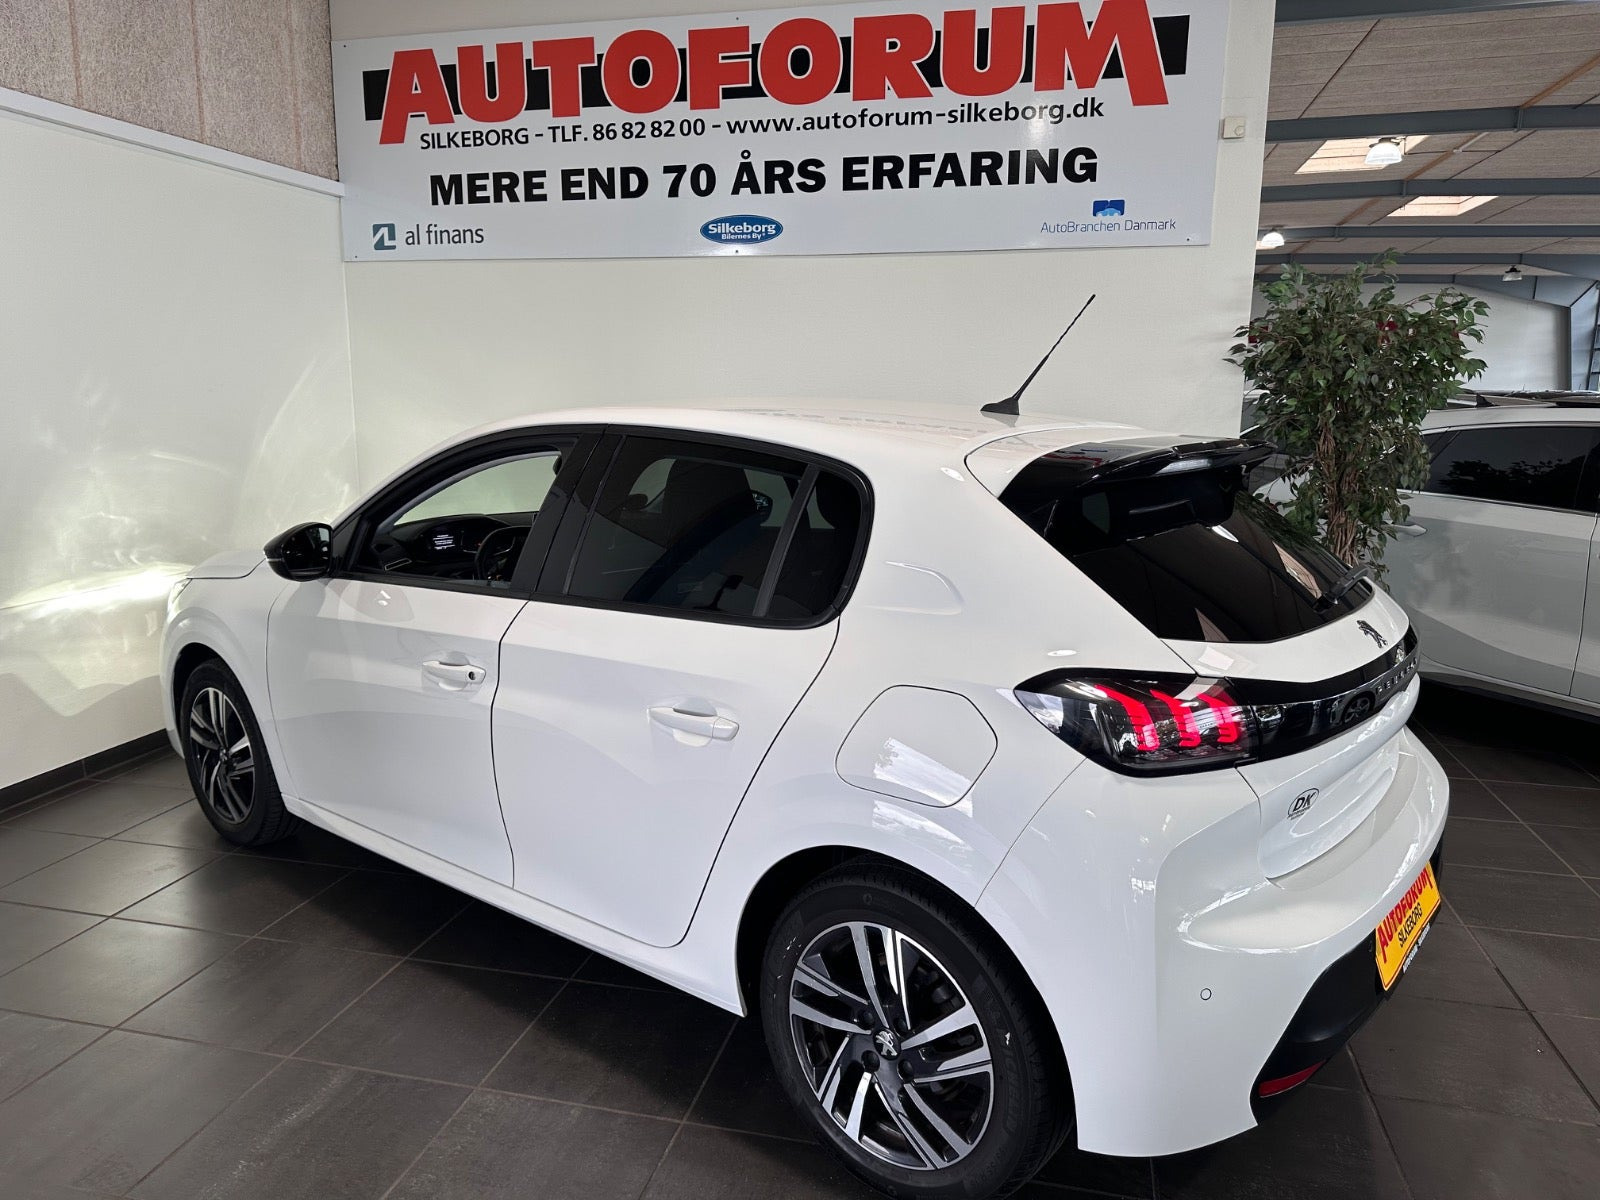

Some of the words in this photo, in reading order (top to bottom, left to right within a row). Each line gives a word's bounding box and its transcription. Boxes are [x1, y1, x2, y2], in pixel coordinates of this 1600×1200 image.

[379, 0, 1169, 145] AUTOFORUM
[419, 128, 530, 151] SILKEBORG
[548, 125, 589, 143] TLF.
[726, 97, 1105, 135] www.autoforum-silkeborg.dk
[429, 169, 548, 207] MERE
[560, 165, 649, 202] END
[662, 162, 717, 199] 70
[730, 149, 827, 196] ÅRS
[842, 146, 1098, 192] ERFARING
[405, 223, 421, 246] al
[425, 223, 485, 245] finans
[708, 222, 777, 235] Silkeborg
[1040, 220, 1121, 234] AutoBranchen
[1124, 219, 1177, 231] Danmark
[1292, 791, 1317, 812] DK
[1376, 866, 1434, 964] AUTOFORUM
[1398, 902, 1423, 948] SILKEBORG
